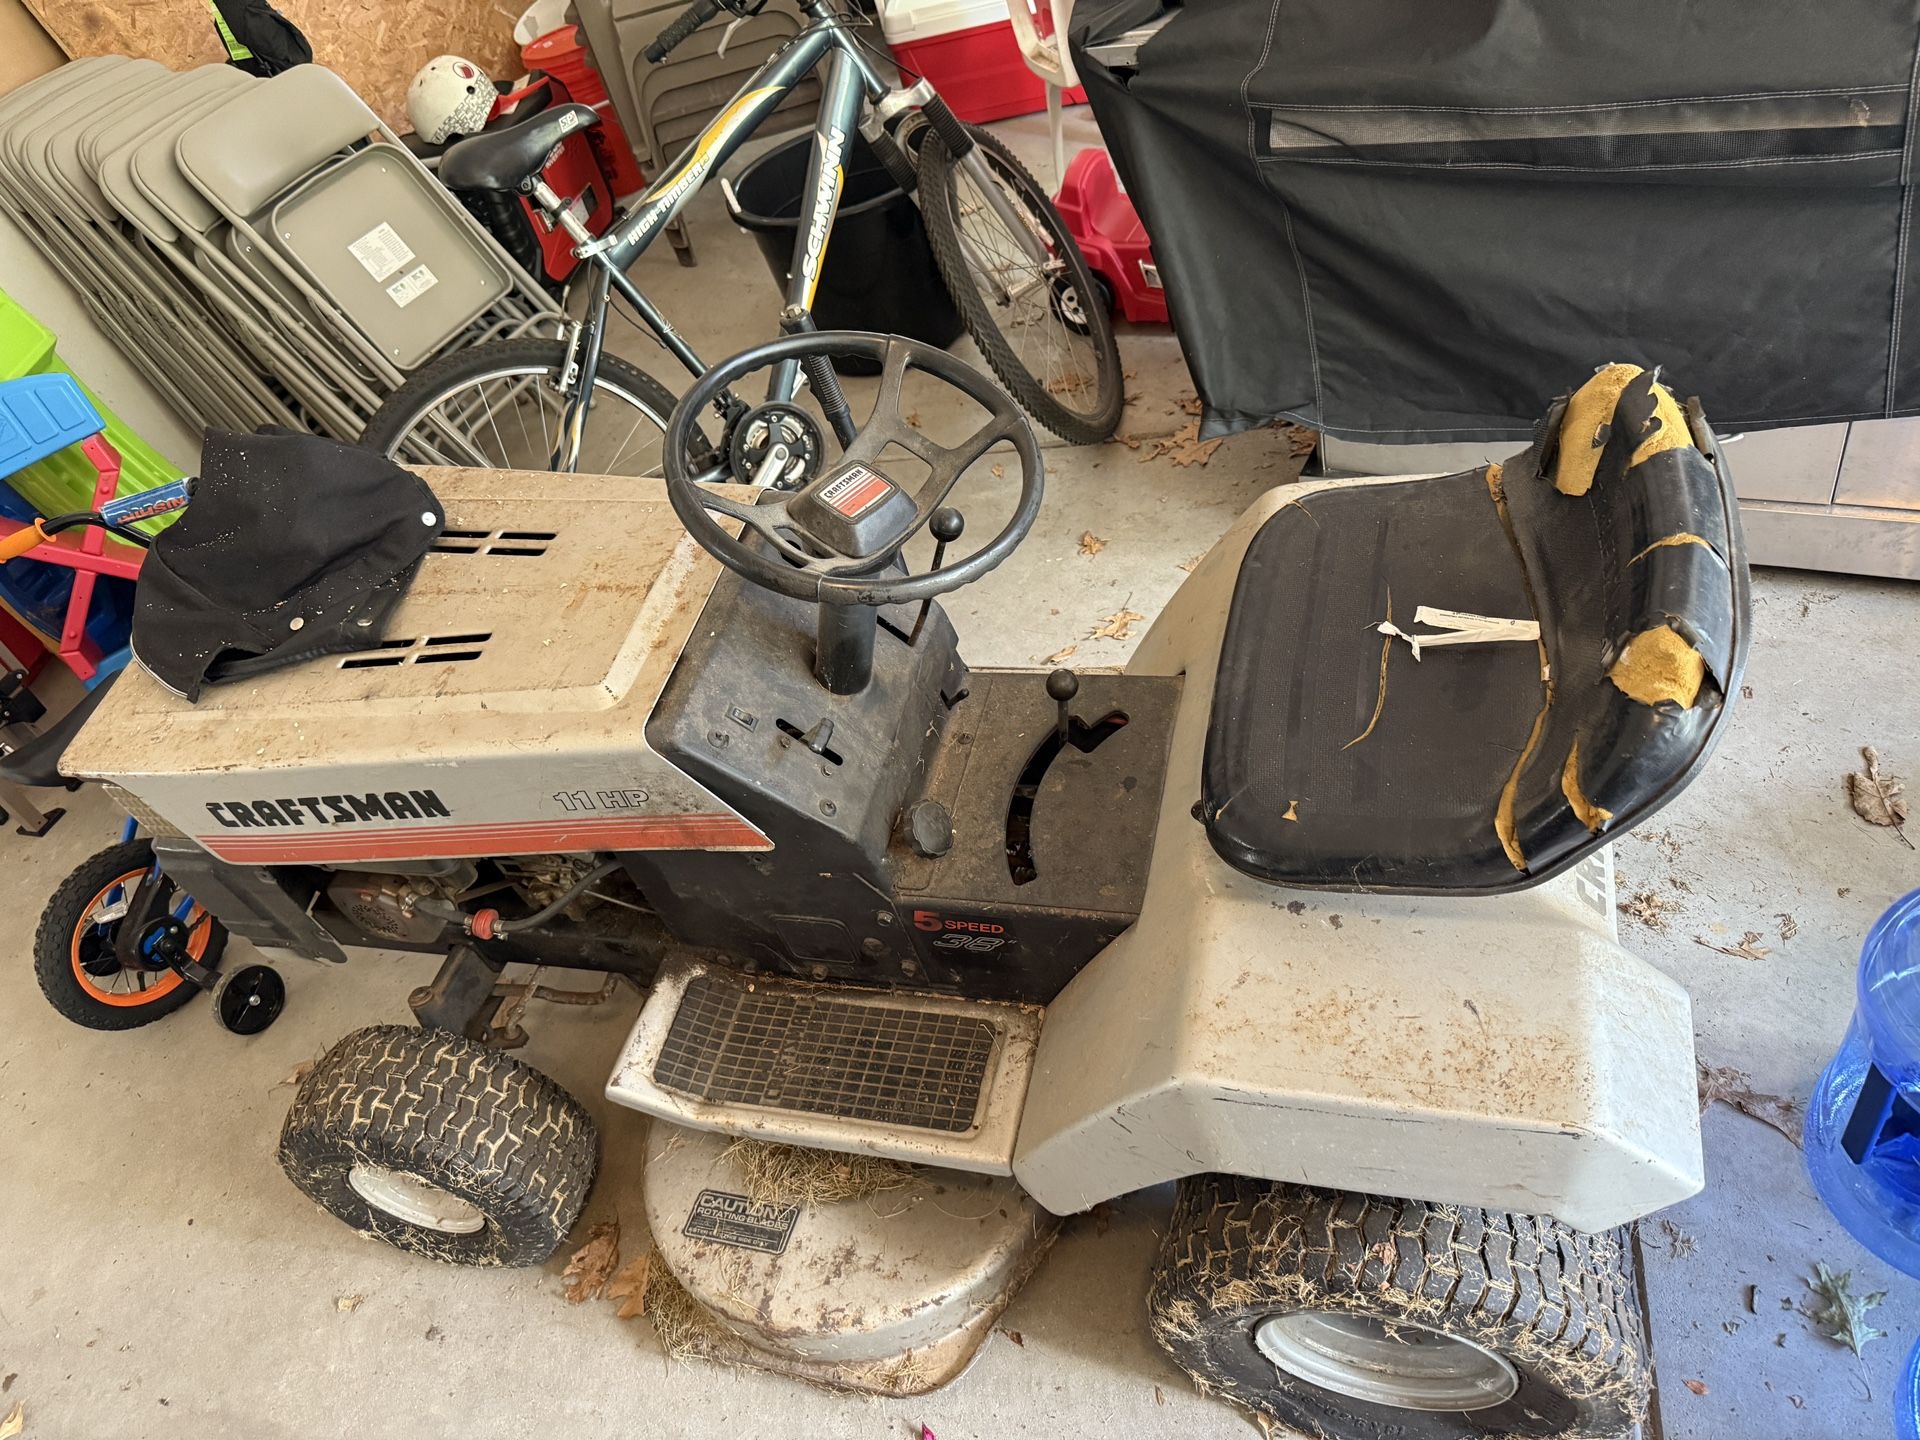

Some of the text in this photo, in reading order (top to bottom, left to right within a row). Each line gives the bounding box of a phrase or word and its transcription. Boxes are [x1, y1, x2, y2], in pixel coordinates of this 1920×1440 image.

[802, 127, 846, 282] SCHWINN
[823, 468, 864, 499] CRAFTSMAN
[205, 789, 452, 828] CRAFTSMAN
[552, 789, 650, 811] 11 HP
[913, 910, 1005, 934] 5 SPEED
[696, 1206, 748, 1224] ROTATING
[746, 1215, 789, 1230] BLADES
